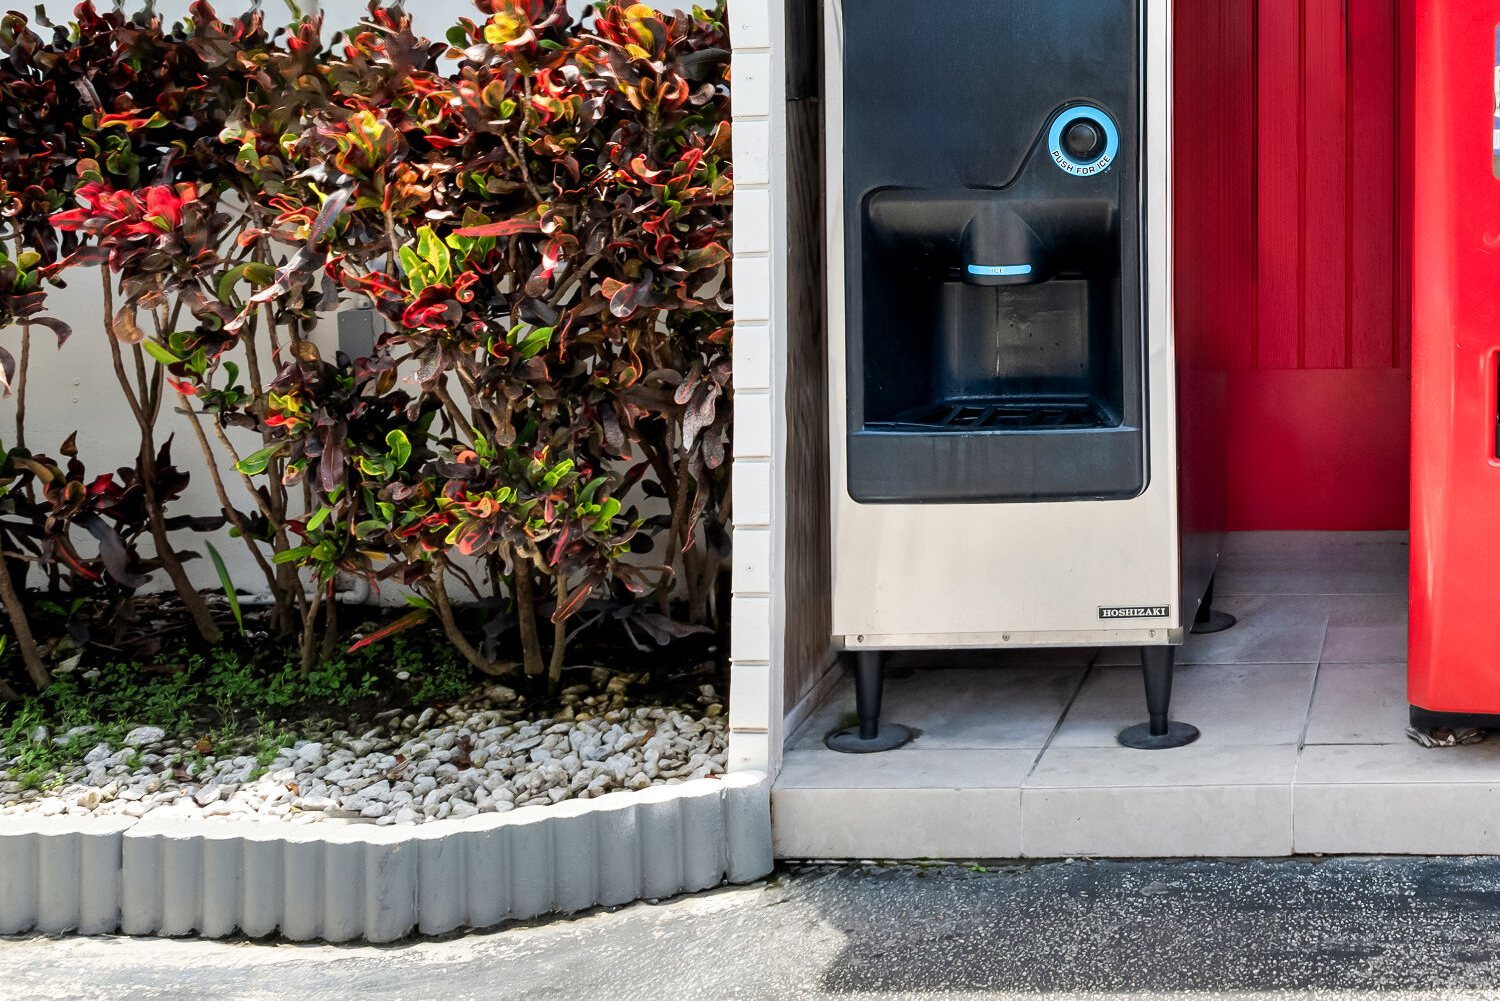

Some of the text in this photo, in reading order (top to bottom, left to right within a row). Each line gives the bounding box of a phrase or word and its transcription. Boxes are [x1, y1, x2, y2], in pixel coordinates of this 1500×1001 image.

[1051, 150, 1111, 175] PUSH FOR ICE
[1102, 608, 1166, 617] HOSHIZAKI
